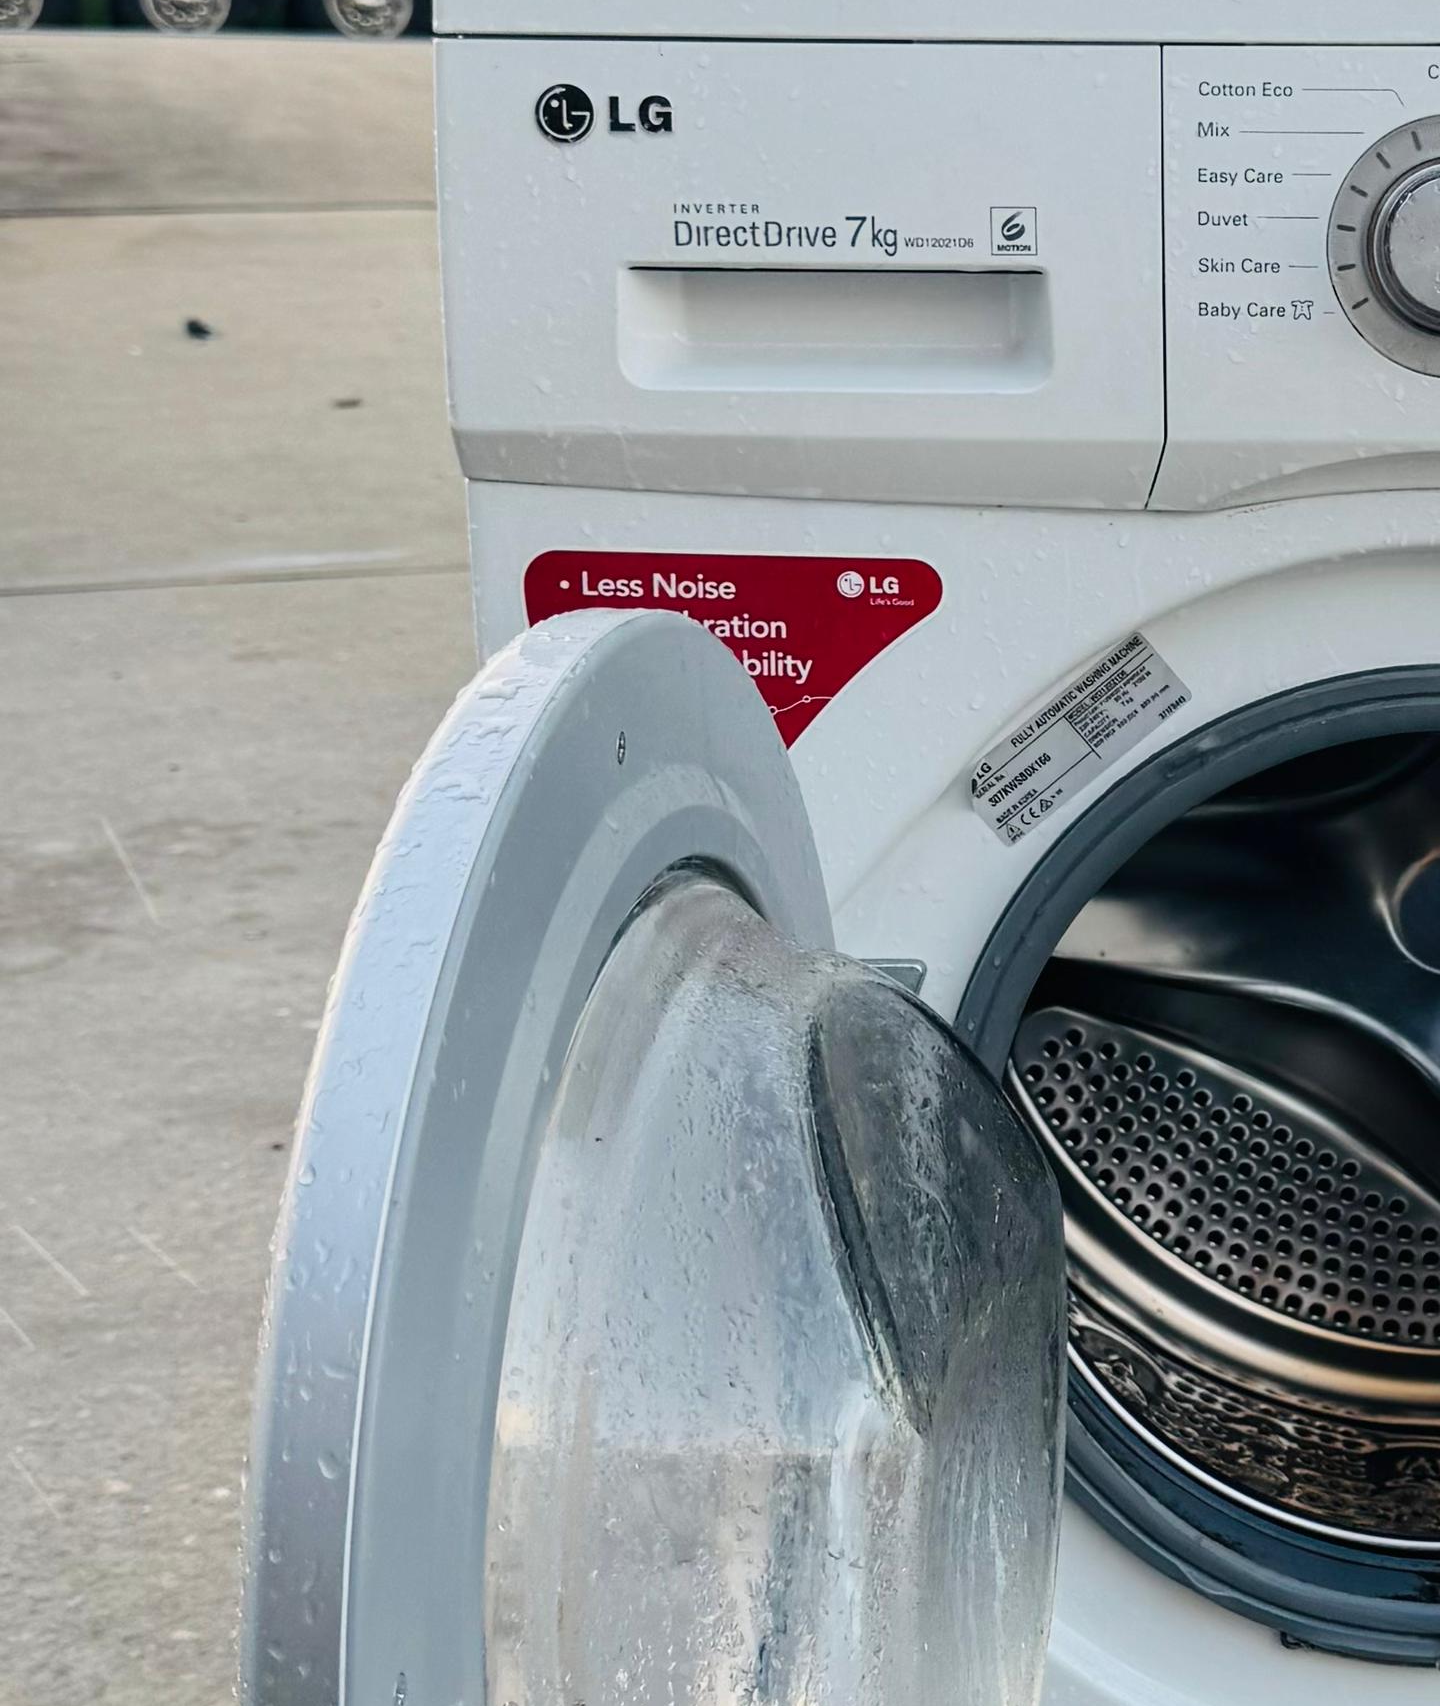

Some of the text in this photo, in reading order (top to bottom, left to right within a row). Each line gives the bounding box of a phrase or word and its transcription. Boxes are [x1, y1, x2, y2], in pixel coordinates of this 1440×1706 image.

[1199, 81, 1293, 97] Cotton Eco
[609, 95, 672, 132] LG
[1197, 122, 1230, 137] Mix
[1198, 168, 1283, 186] Easy Care
[673, 204, 760, 215] INVERTER
[1198, 211, 1249, 226] Duvet
[997, 244, 1031, 252] MOTION
[1198, 257, 1280, 273] Skin Care
[1198, 302, 1286, 320] Baby Care
[581, 571, 737, 600] Less Noise
[869, 576, 900, 594] LG
[892, 598, 915, 606] Good
[684, 610, 787, 639] ration
[742, 649, 813, 685] bility
[1011, 725, 1036, 748] FULLY
[1034, 691, 1077, 730] AUTOMATIC
[1075, 662, 1111, 694] WASHING
[1108, 635, 1143, 667] MACHINE
